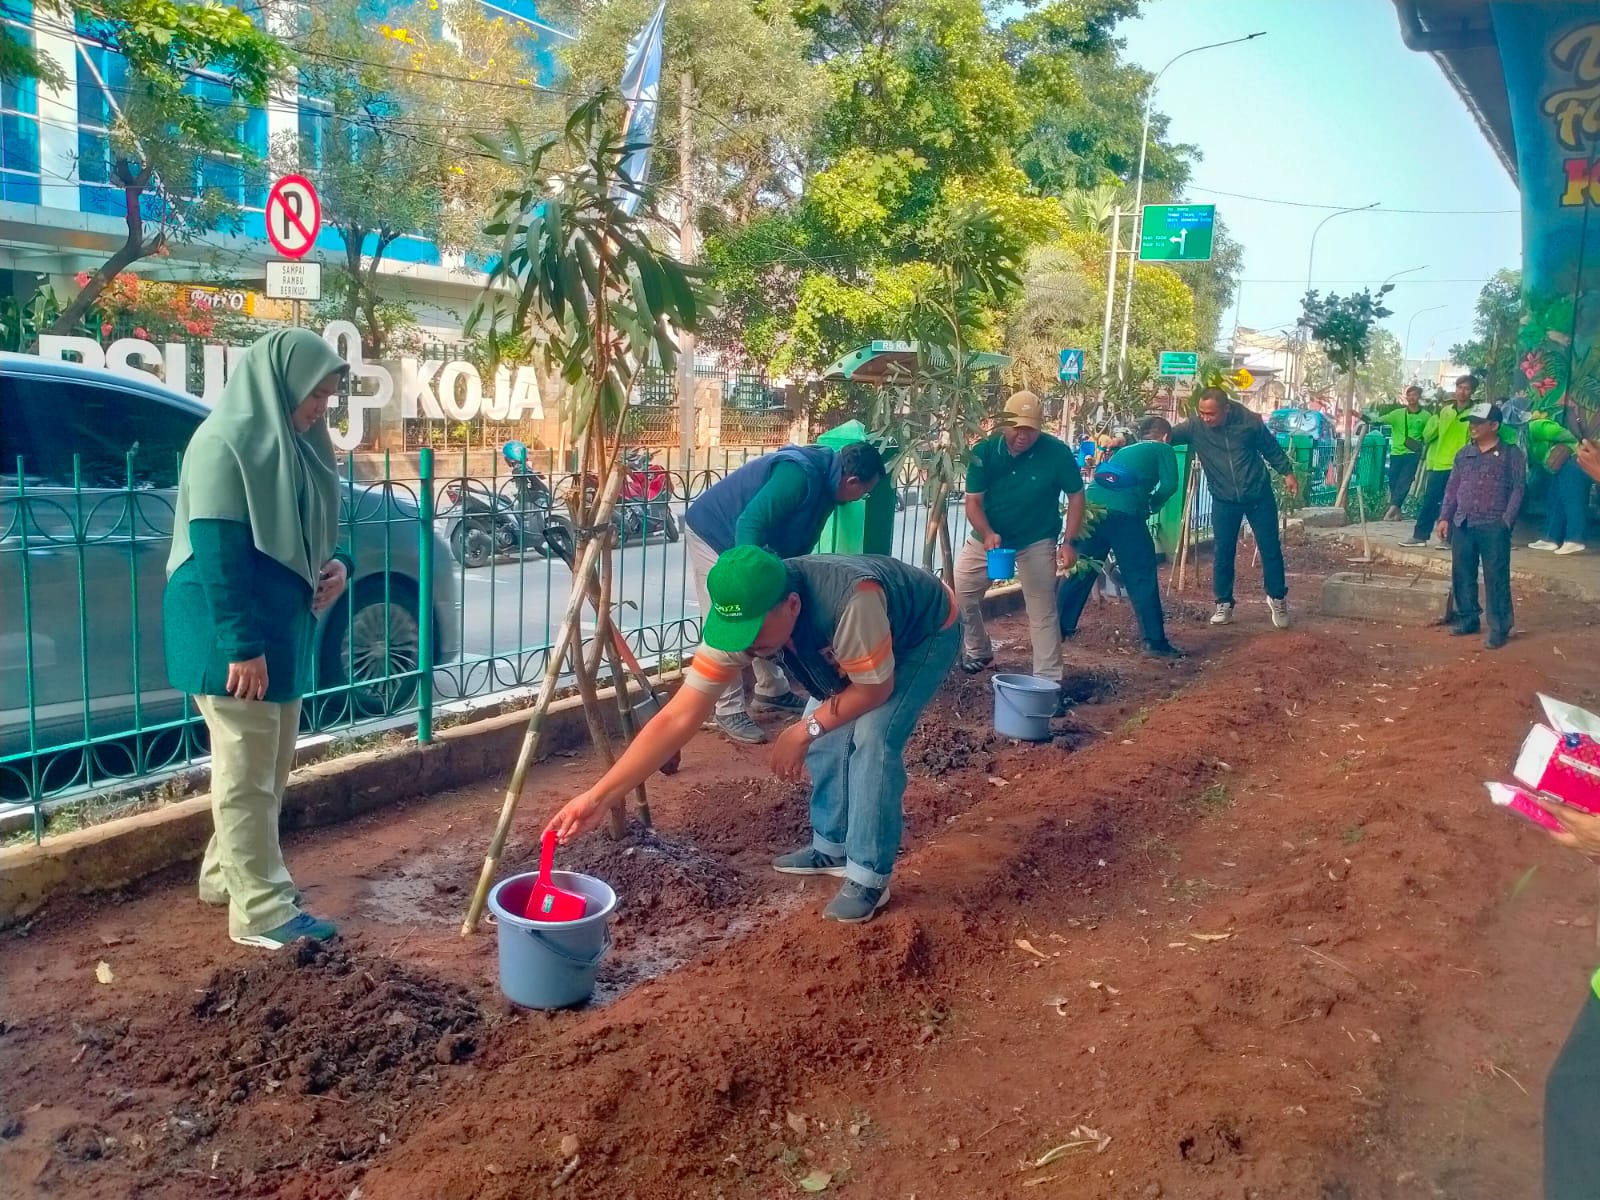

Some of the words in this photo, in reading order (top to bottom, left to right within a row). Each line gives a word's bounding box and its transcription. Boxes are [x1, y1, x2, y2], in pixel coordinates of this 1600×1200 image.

[282, 265, 305, 275] SAMPAI
[282, 275, 304, 285] RAMBU
[401, 358, 545, 421] KOJA
